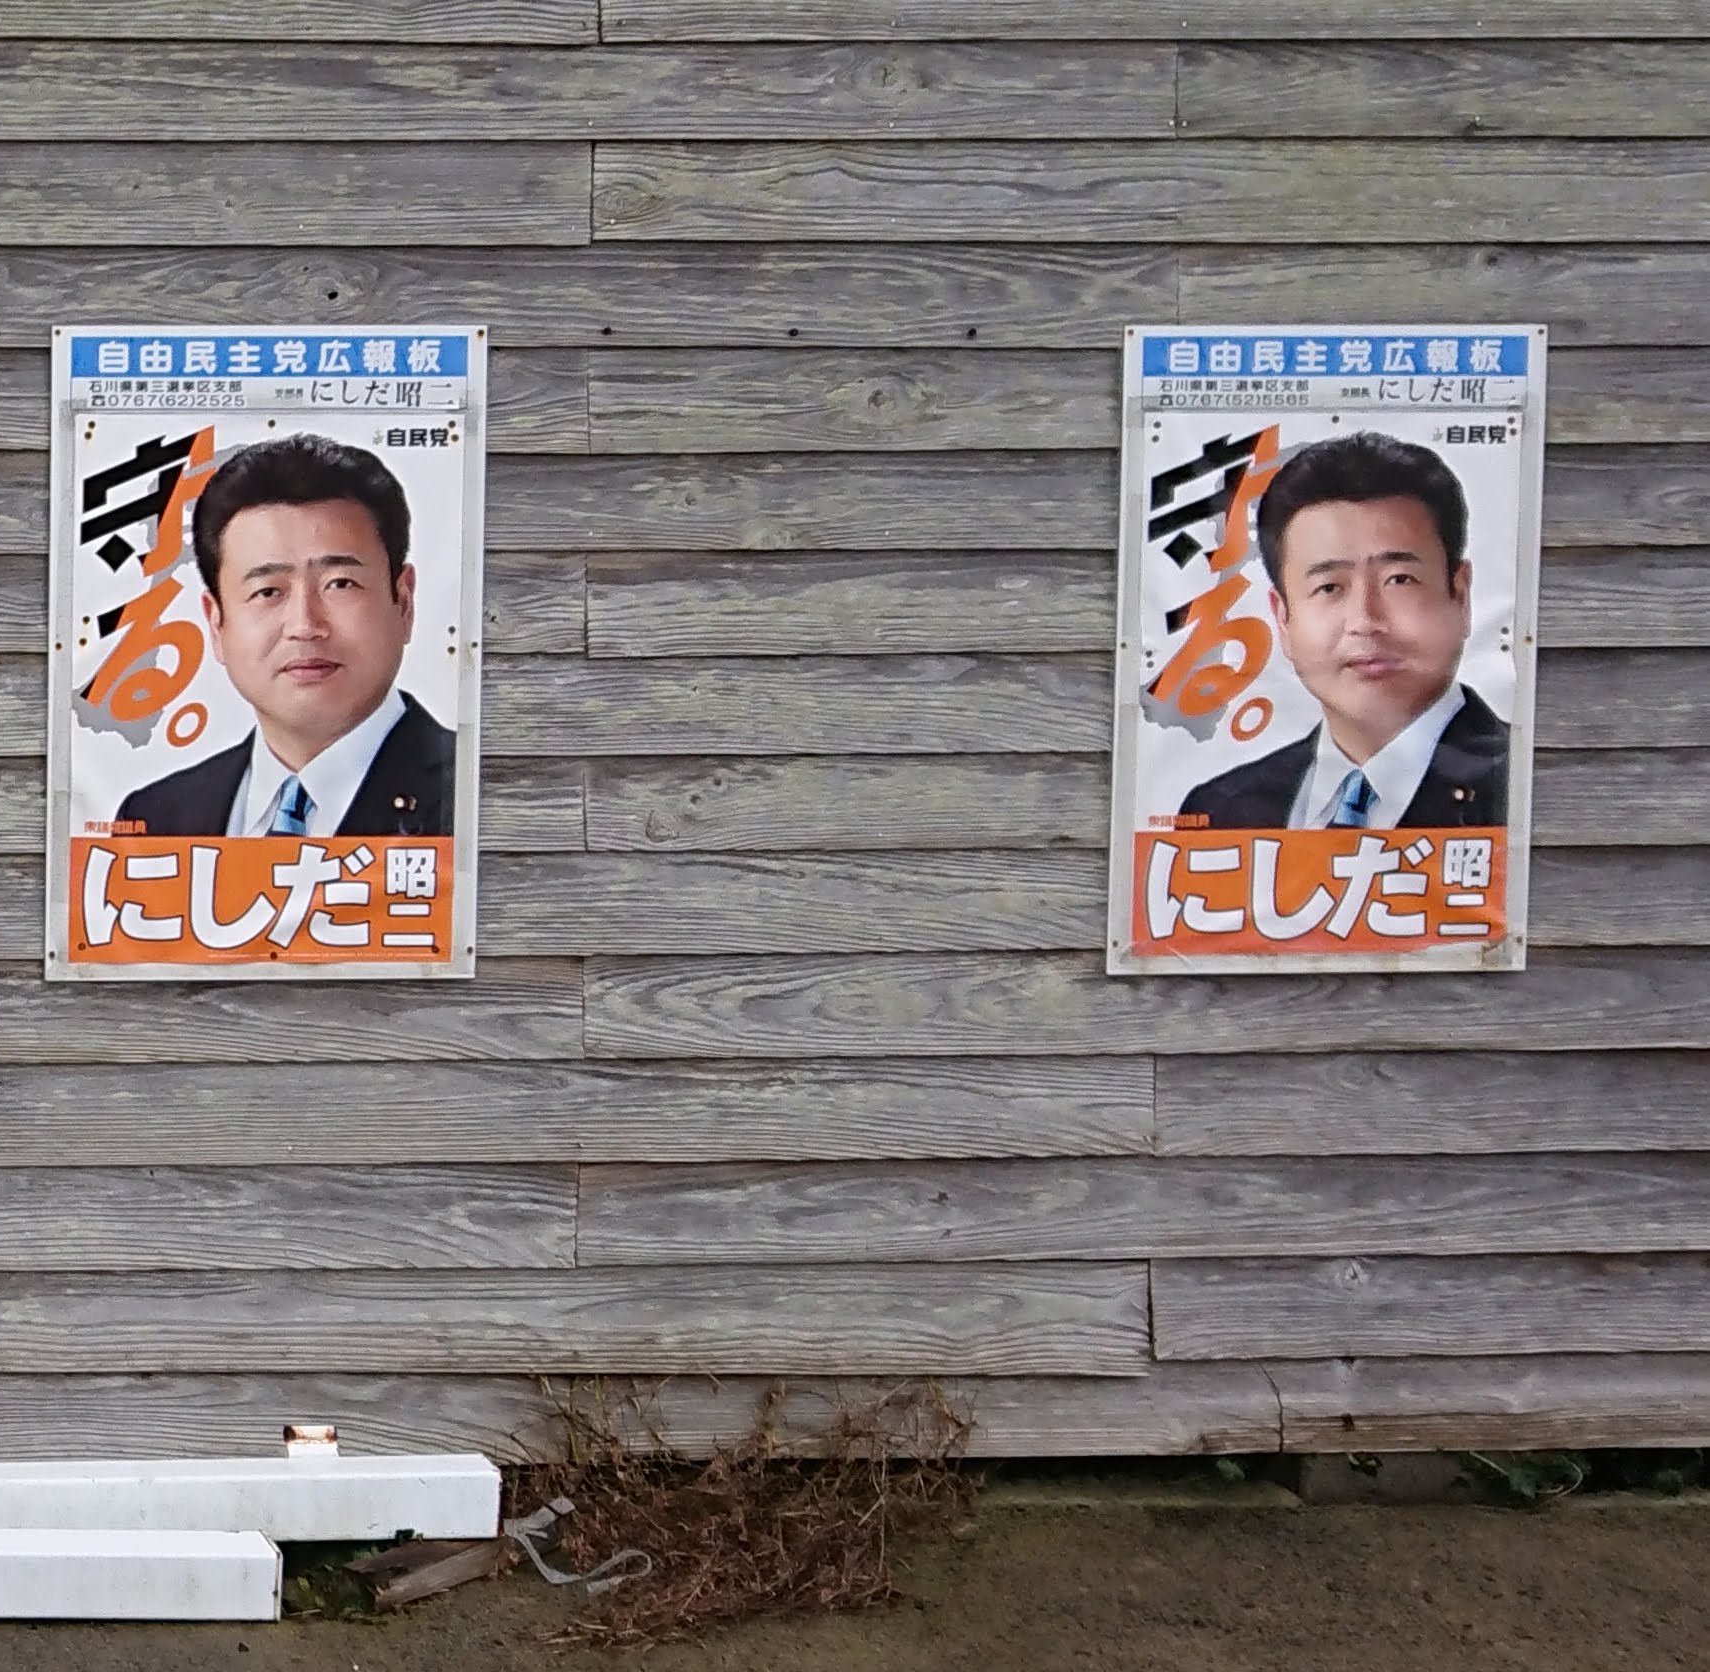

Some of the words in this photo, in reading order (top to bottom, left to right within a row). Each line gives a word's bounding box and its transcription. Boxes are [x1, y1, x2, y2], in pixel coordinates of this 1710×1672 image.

[97, 339, 442, 374] 自由民主党広報板
[1167, 340, 1503, 374] 自由民主党広報板
[89, 380, 243, 393] 石川県第三選挙区支部
[310, 380, 455, 407] にしだ昭二
[1378, 377, 1516, 404] にしだ昭二
[386, 428, 449, 447] 自民党
[1445, 425, 1508, 444] 自民党
[79, 424, 218, 748] 守る。
[1146, 423, 1281, 742] 守る。
[82, 843, 376, 950] にしだ
[384, 846, 438, 948] 昭二
[1145, 835, 1434, 940] にしだ
[1437, 838, 1492, 936] 昭二
